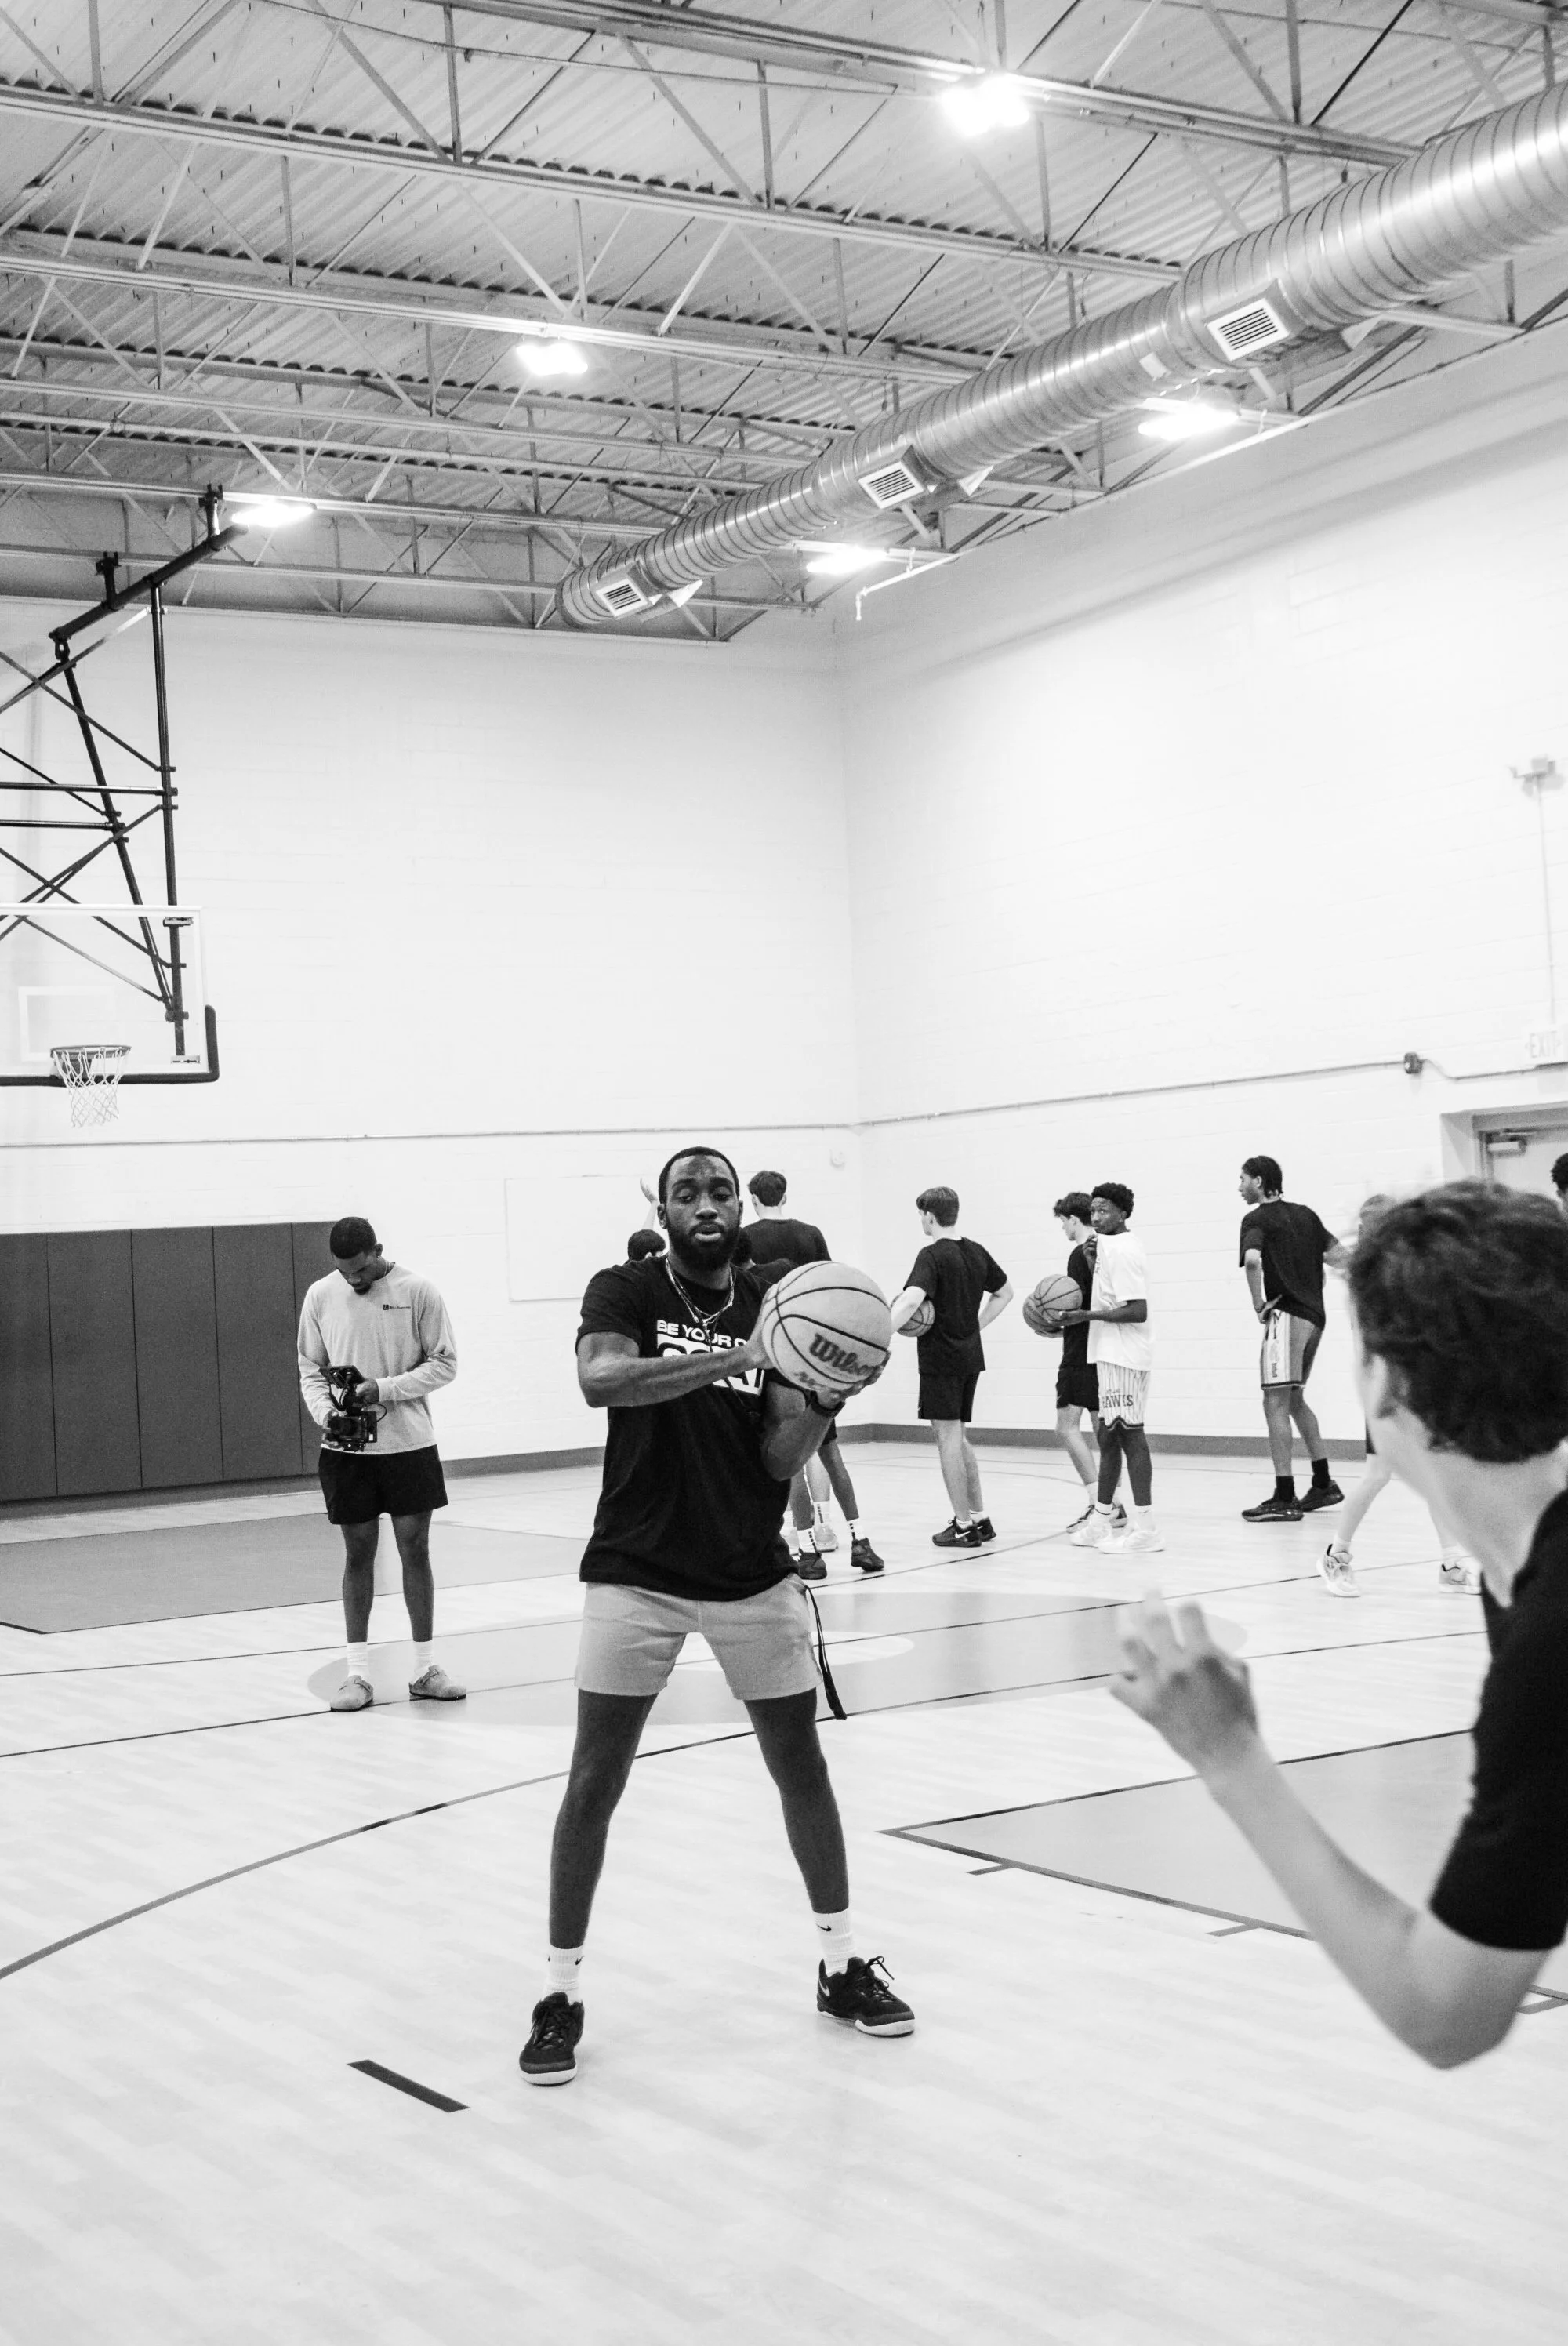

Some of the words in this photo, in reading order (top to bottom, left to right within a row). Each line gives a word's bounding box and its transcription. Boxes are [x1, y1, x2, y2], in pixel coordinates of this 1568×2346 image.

[1530, 1030, 1557, 1058] EXIT
[657, 1320, 679, 1335] BE
[682, 1324, 731, 1347] YOUR
